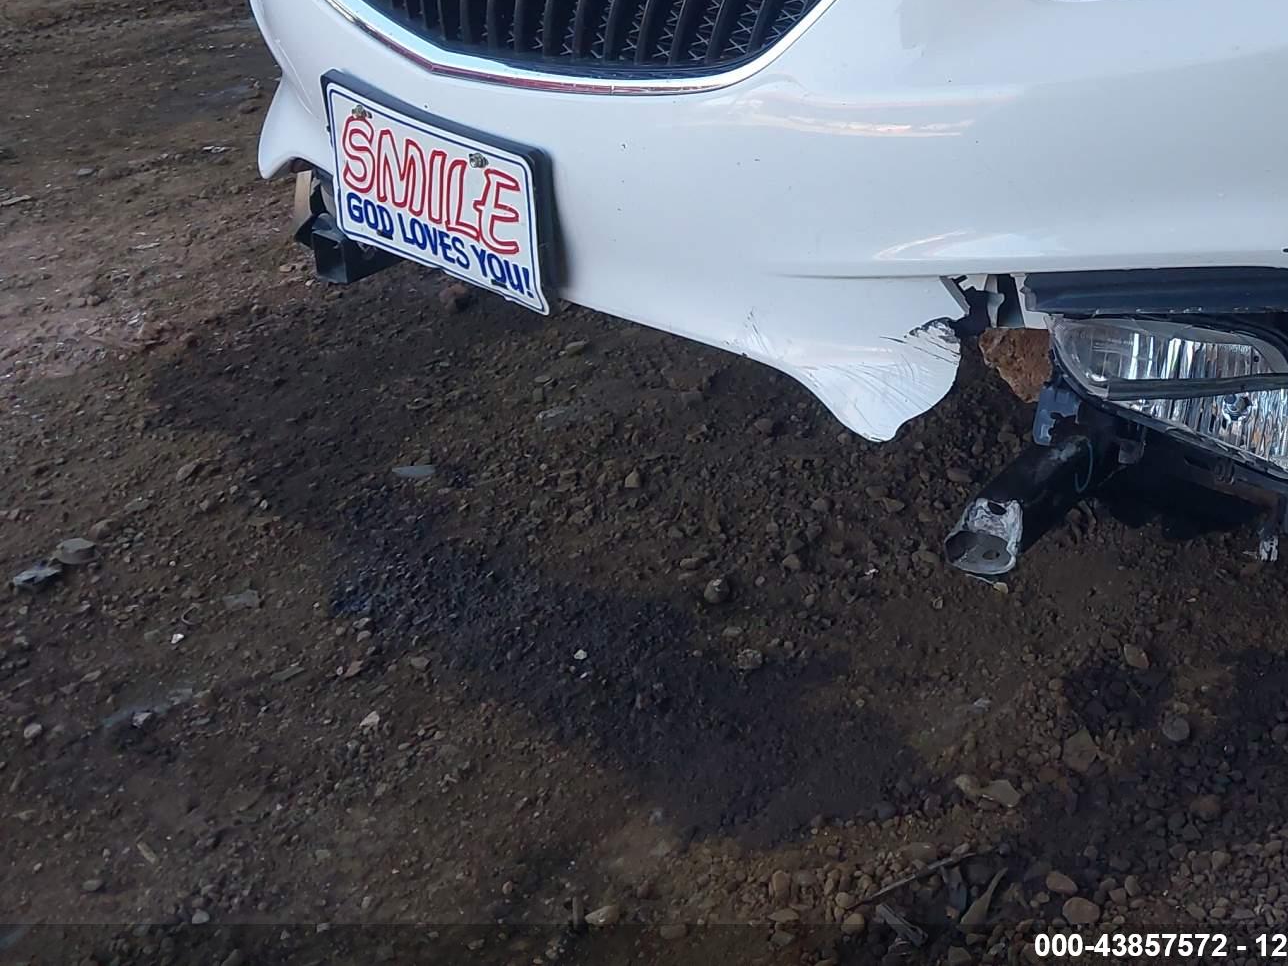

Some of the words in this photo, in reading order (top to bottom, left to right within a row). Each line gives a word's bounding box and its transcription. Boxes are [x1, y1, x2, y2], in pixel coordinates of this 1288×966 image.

[342, 114, 521, 255] SMILE
[346, 192, 394, 237] GOD
[397, 213, 471, 269] LOVES
[471, 245, 534, 298] YOU!
